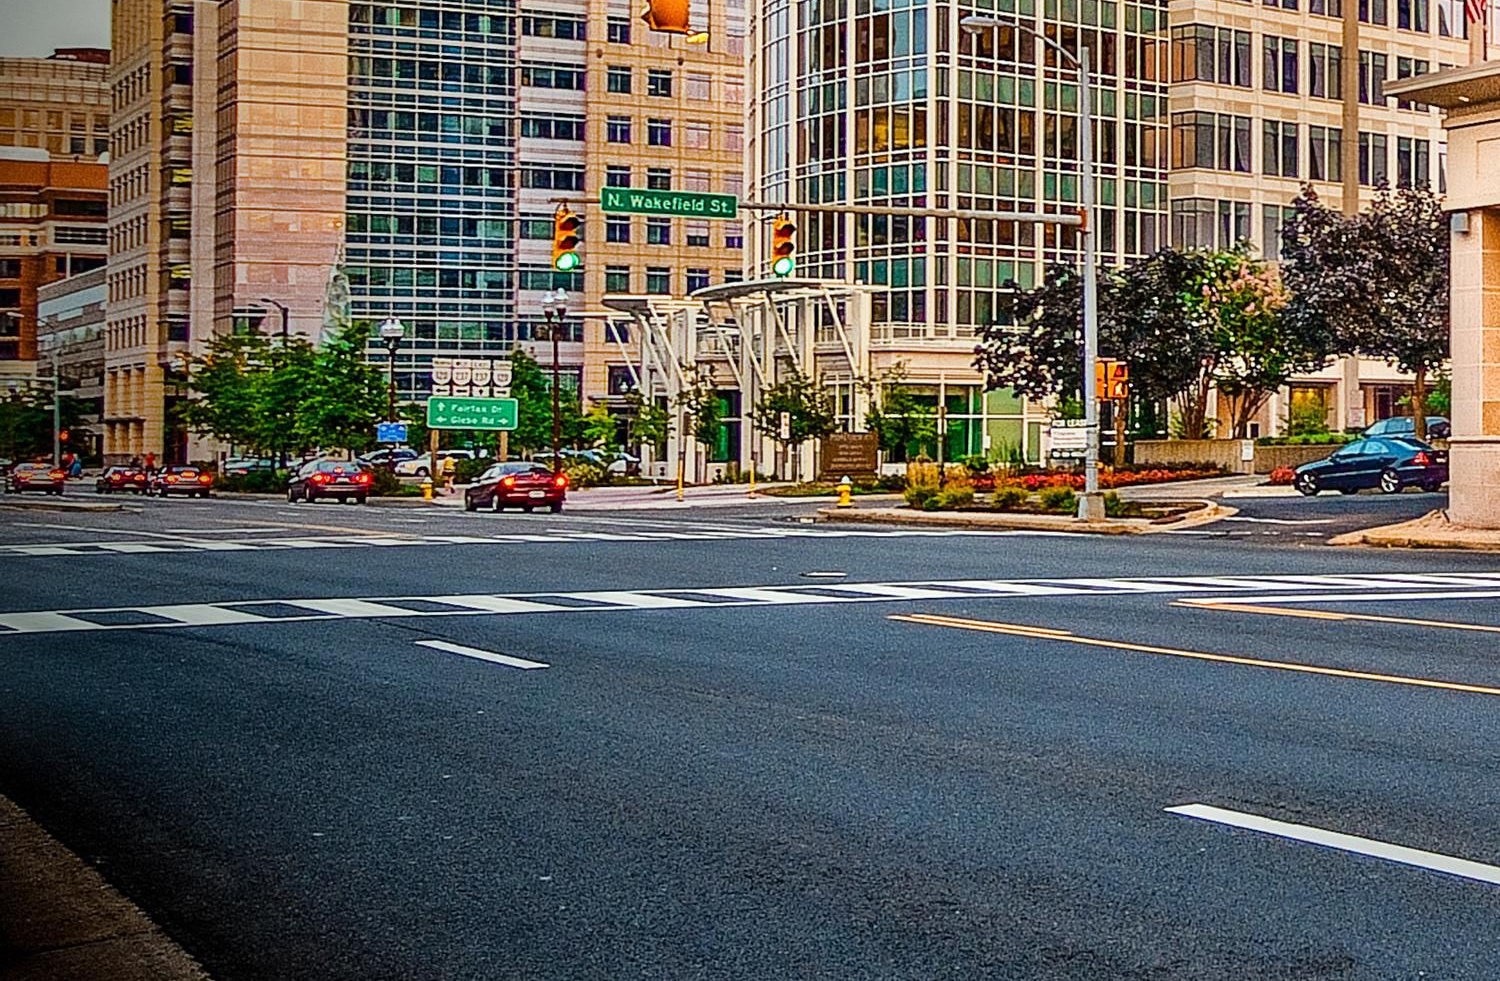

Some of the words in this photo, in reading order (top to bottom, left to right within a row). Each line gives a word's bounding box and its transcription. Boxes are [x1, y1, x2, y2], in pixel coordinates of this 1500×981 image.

[607, 193, 625, 207] N.
[630, 195, 704, 212] Wakefield
[709, 199, 733, 214] St.
[451, 404, 487, 413] Fairfax
